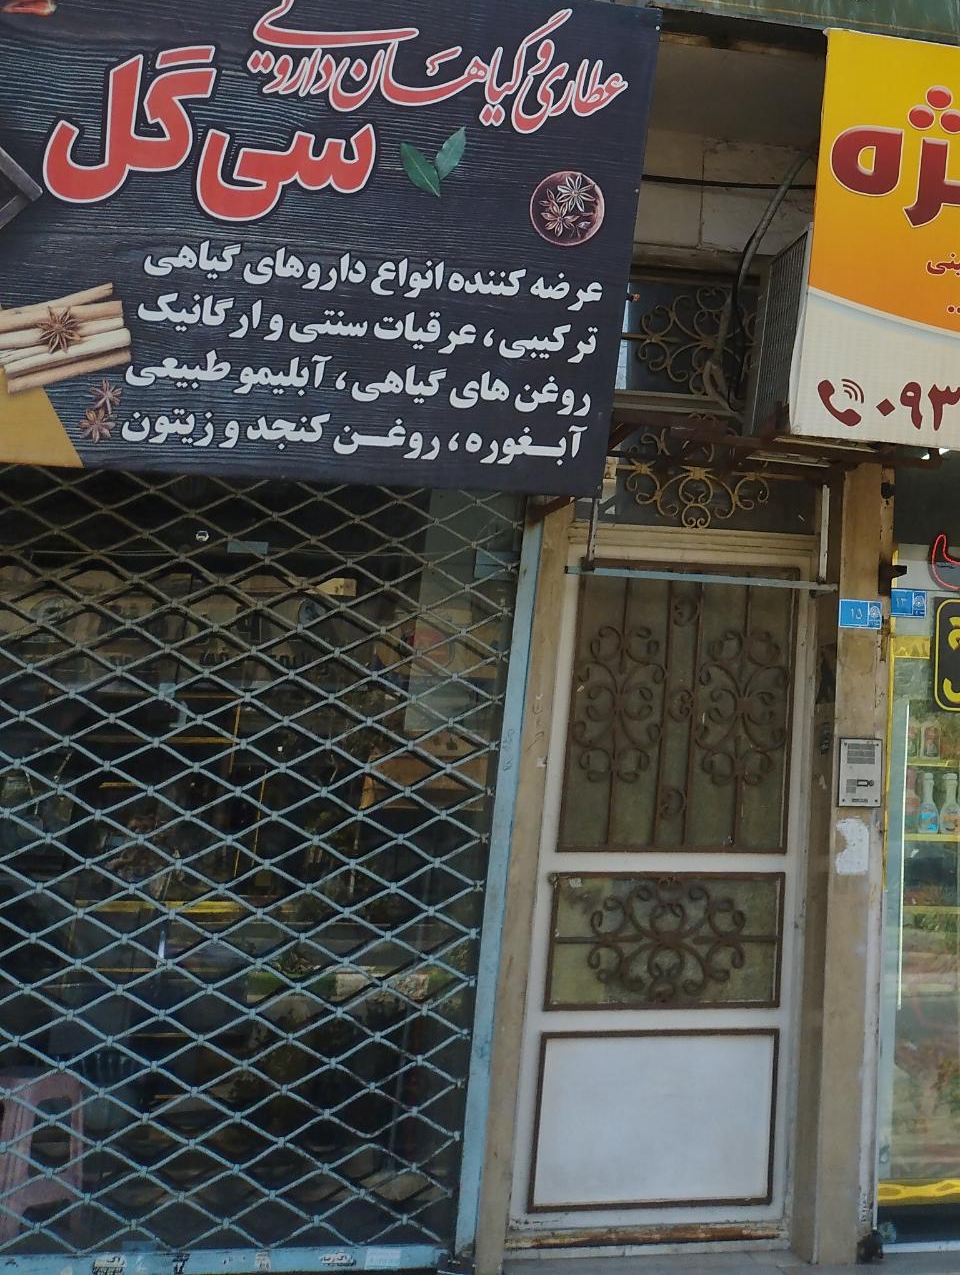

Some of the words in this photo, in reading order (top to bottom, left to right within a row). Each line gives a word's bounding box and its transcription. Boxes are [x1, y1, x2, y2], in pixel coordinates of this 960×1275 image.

[328, 7, 574, 127] گیاهان
[511, 58, 629, 135] عطاری
[41, 43, 218, 205] گل
[194, 121, 378, 224] سی
[142, 238, 241, 280] گیاهی
[242, 245, 368, 292] داروهای
[369, 257, 445, 296] انواع
[447, 268, 527, 301] کننده
[529, 269, 604, 312] عرضه
[136, 291, 262, 342] ارگانیک
[267, 312, 285, 342] و
[288, 307, 368, 344] سنتی
[373, 309, 478, 356] عرقیات
[123, 349, 232, 391] طبیعی
[232, 354, 333, 397] آبلیمو
[447, 370, 511, 409] های
[513, 374, 593, 417] روغن
[119, 407, 214, 448] زیتون
[223, 419, 241, 447] و
[244, 412, 331, 451] کنجد
[332, 418, 441, 461] روغن
